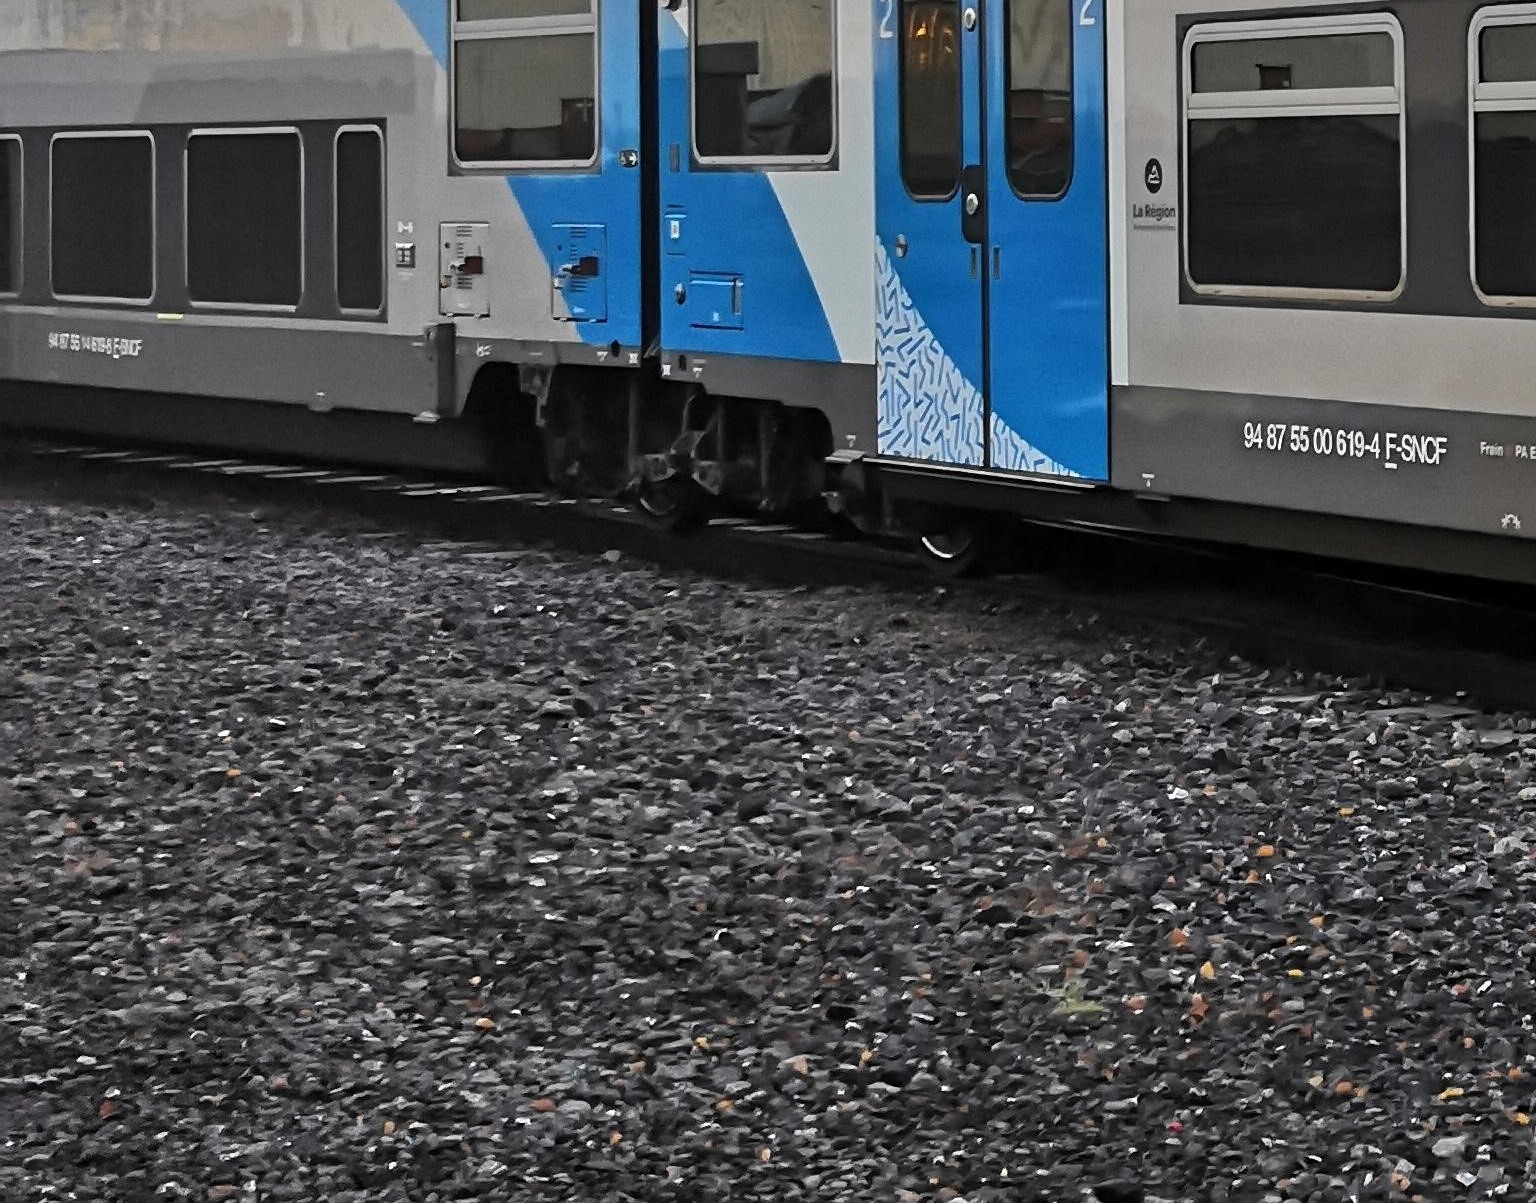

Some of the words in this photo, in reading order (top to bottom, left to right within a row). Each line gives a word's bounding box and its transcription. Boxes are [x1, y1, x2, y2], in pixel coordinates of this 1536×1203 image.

[1132, 203, 1143, 218] La
[1144, 203, 1177, 222] Région
[1243, 422, 1263, 449] 94
[1266, 423, 1287, 451] 87
[1290, 424, 1310, 453] 55
[1313, 427, 1333, 455] 00
[1336, 429, 1381, 459] 619-4
[1384, 432, 1448, 469] F-SNCF
